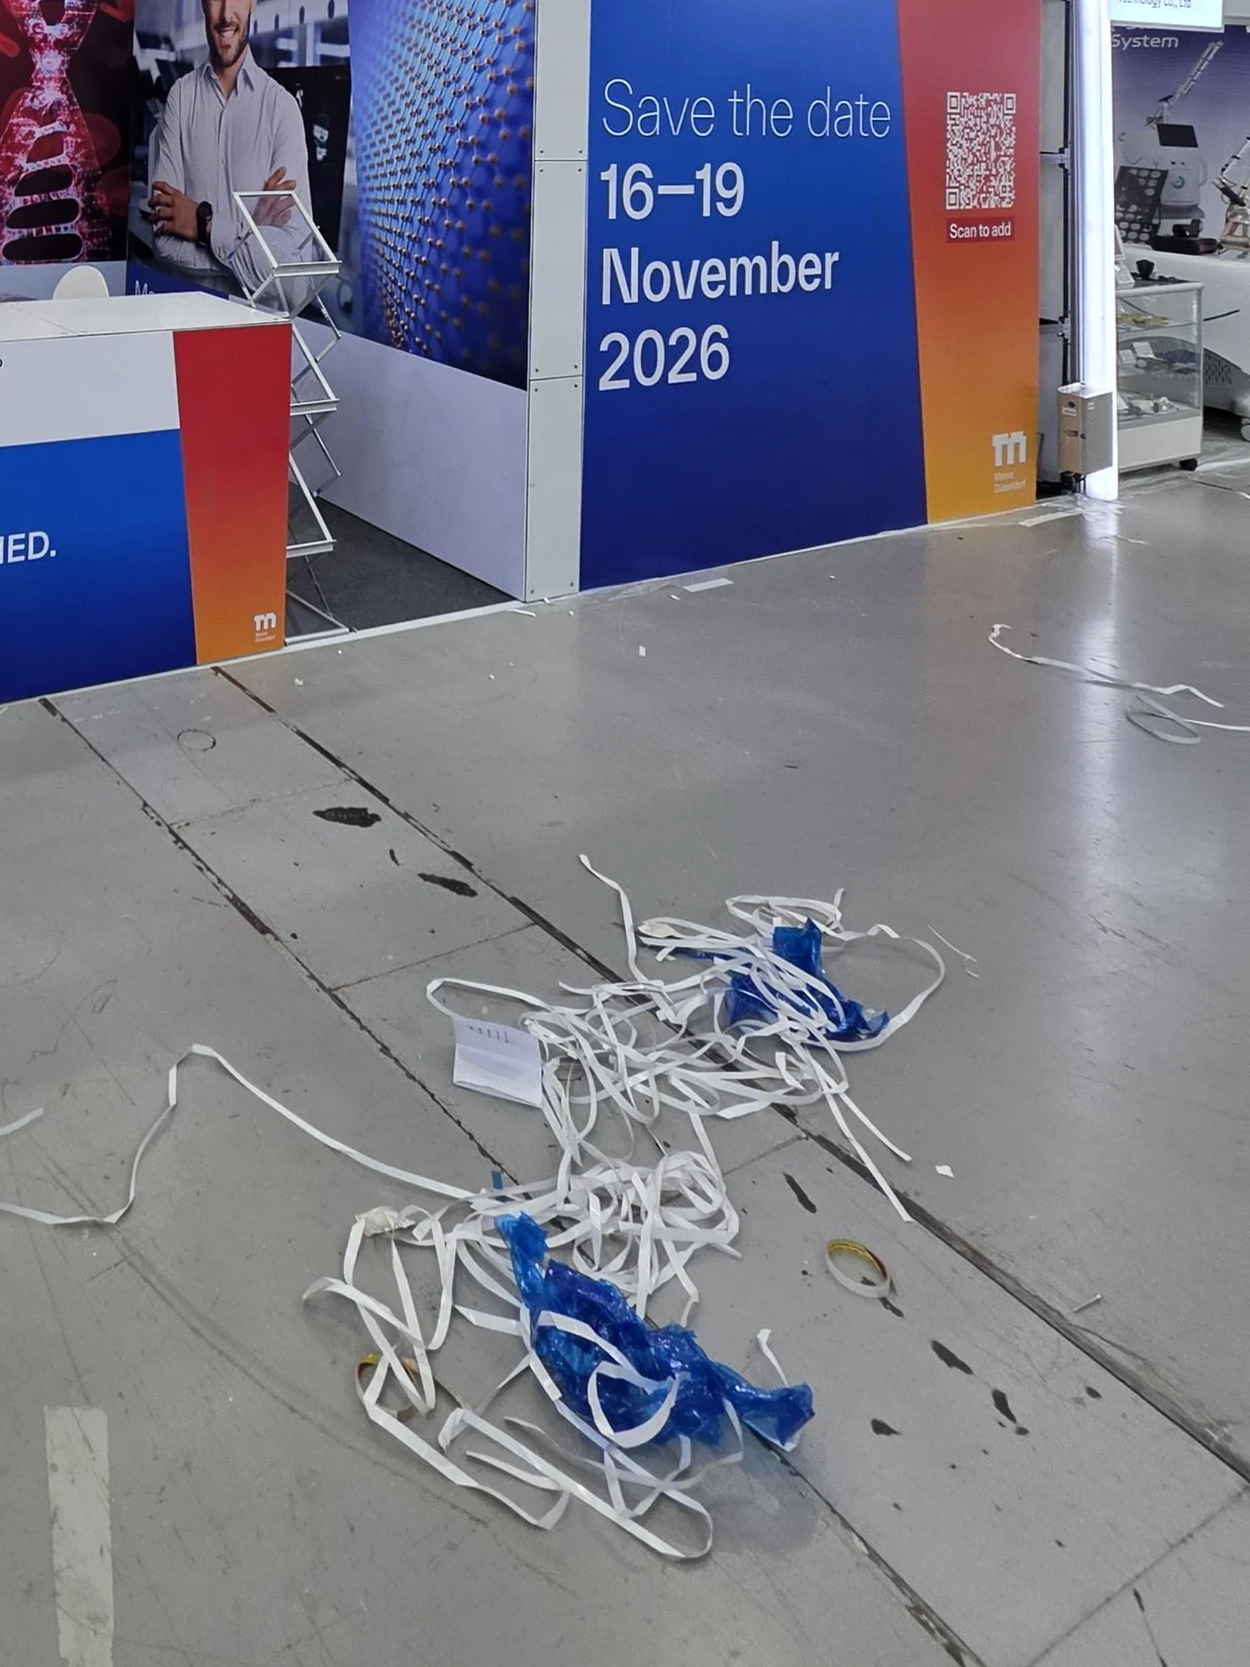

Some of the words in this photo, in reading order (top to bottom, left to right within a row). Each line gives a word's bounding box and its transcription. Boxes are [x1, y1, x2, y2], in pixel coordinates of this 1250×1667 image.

[1111, 34, 1179, 50] System
[602, 78, 715, 137] Save
[727, 83, 793, 137] the
[807, 86, 891, 138] date
[950, 223, 977, 238] Scan
[978, 224, 990, 237] to
[991, 221, 1012, 237] add
[601, 240, 840, 305] November
[598, 324, 730, 391] 2026
